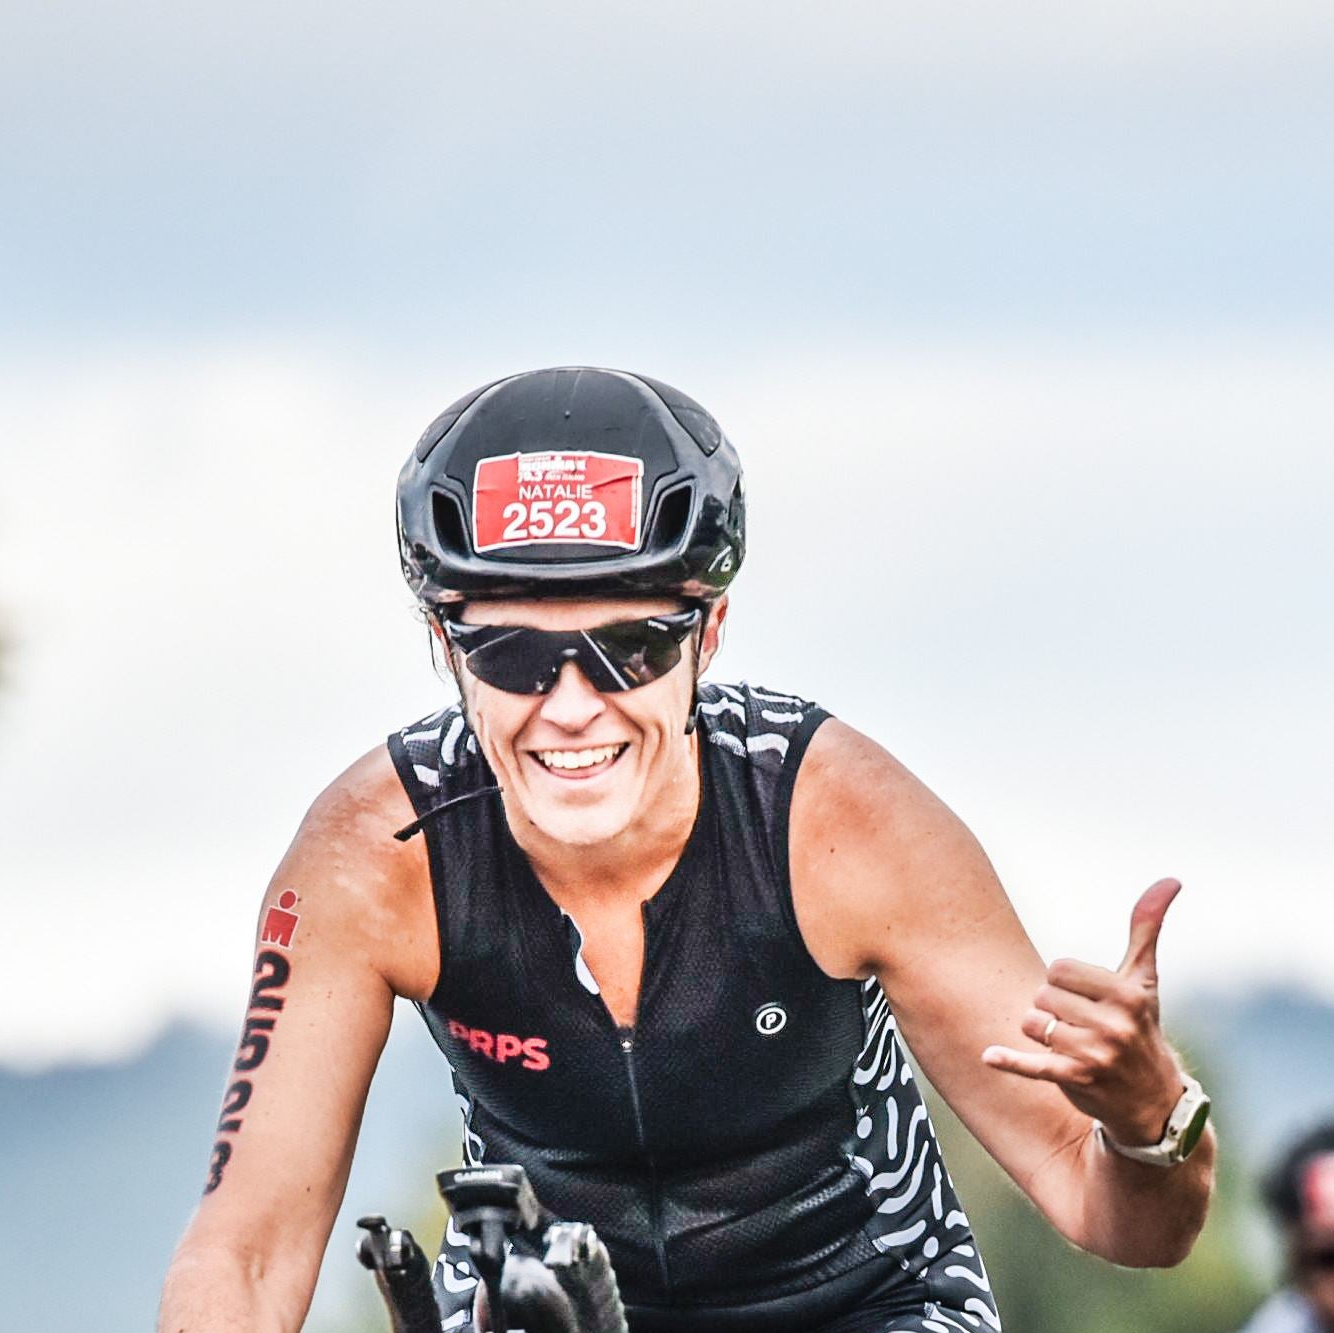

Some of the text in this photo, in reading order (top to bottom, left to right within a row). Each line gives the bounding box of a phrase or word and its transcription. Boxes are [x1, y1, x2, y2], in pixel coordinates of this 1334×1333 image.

[518, 484, 594, 500] NATALIE
[502, 501, 607, 540] 2523
[202, 950, 291, 1196] 2523
